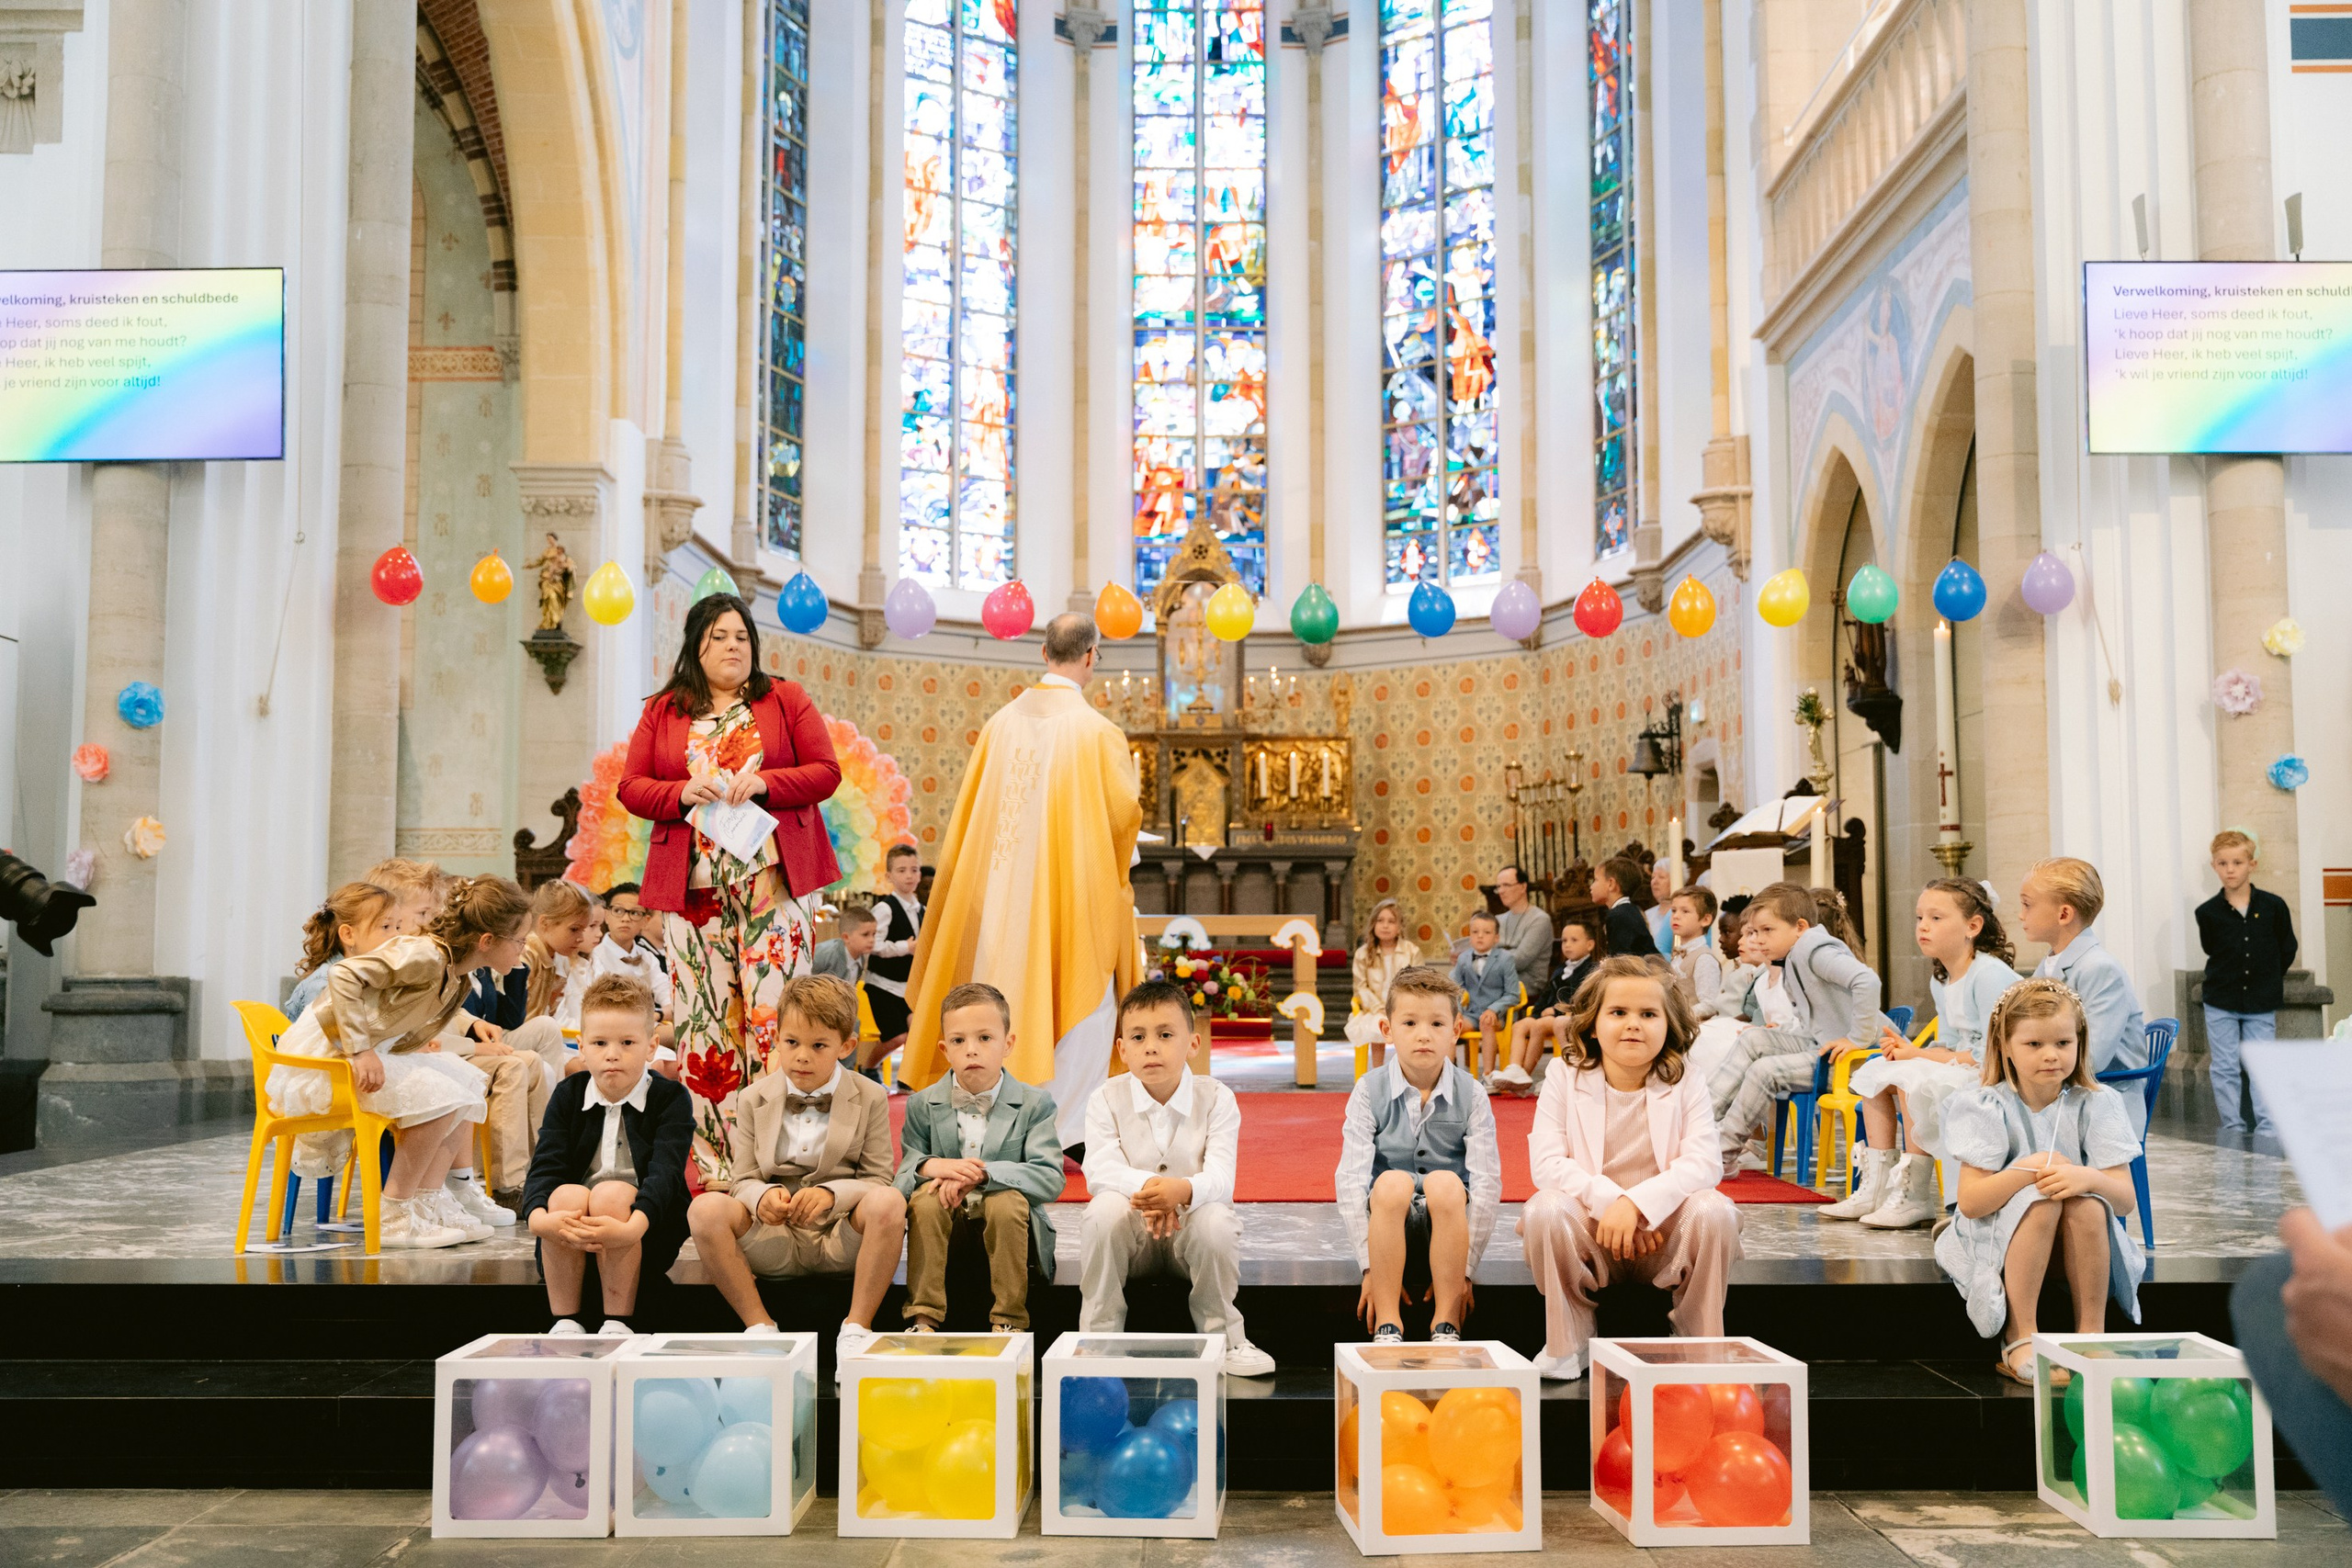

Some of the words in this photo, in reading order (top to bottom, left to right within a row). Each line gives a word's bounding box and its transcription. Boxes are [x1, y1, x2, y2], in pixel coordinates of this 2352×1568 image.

[2113, 285, 2211, 299] Verwelkoming,
[2214, 285, 2283, 296] kruisteken
[2287, 288, 2302, 297] en
[2306, 286, 2352, 297] schuld
[0, 294, 66, 308] elkoming,
[70, 293, 139, 304] kruisteken
[142, 295, 158, 304] en
[162, 293, 239, 304] schuldbede
[2114, 309, 2148, 320] Lieve
[2152, 309, 2187, 321] Heer,
[2190, 310, 2227, 320] soms
[2231, 309, 2264, 320] deed
[2267, 309, 2278, 320] ik
[2282, 309, 2312, 321] fout,
[6, 317, 41, 329] Heer,
[45, 318, 82, 328] soms
[85, 316, 119, 328] deed
[122, 316, 132, 327] ik
[137, 316, 167, 328] fout,
[2130, 329, 2164, 342] hoop
[2167, 329, 2188, 340] dat
[2191, 329, 2202, 342] jij
[2206, 330, 2231, 342] nog
[2233, 331, 2257, 340] van
[2261, 331, 2282, 340] me
[2286, 328, 2333, 340] houdt?
[20, 337, 41, 348] dat
[44, 336, 56, 350] jij
[60, 338, 85, 350] nog
[87, 338, 111, 347] van
[115, 337, 136, 346] me
[140, 335, 187, 346] houdt?
[6, 356, 40, 368] Heer,
[44, 356, 55, 367] ik
[59, 356, 85, 367] heb
[87, 356, 115, 367] veel
[119, 355, 151, 369] spijt,
[2115, 348, 2149, 359] Lieve
[2153, 348, 2188, 360] Heer,
[2192, 348, 2202, 359] ik
[2206, 349, 2231, 359] heb
[2234, 349, 2262, 359] veel
[2266, 348, 2298, 362] spijt,
[2130, 368, 2148, 379] wil
[2152, 368, 2164, 381] je
[2167, 368, 2208, 379] vriend
[2212, 368, 2234, 381] zijn
[2237, 370, 2267, 379] voor
[2270, 368, 2308, 382] altijd!
[4, 377, 16, 390] je
[18, 377, 61, 388] vriend
[64, 377, 86, 390] zijn
[90, 378, 119, 388] voor
[123, 376, 161, 389] altijd!
